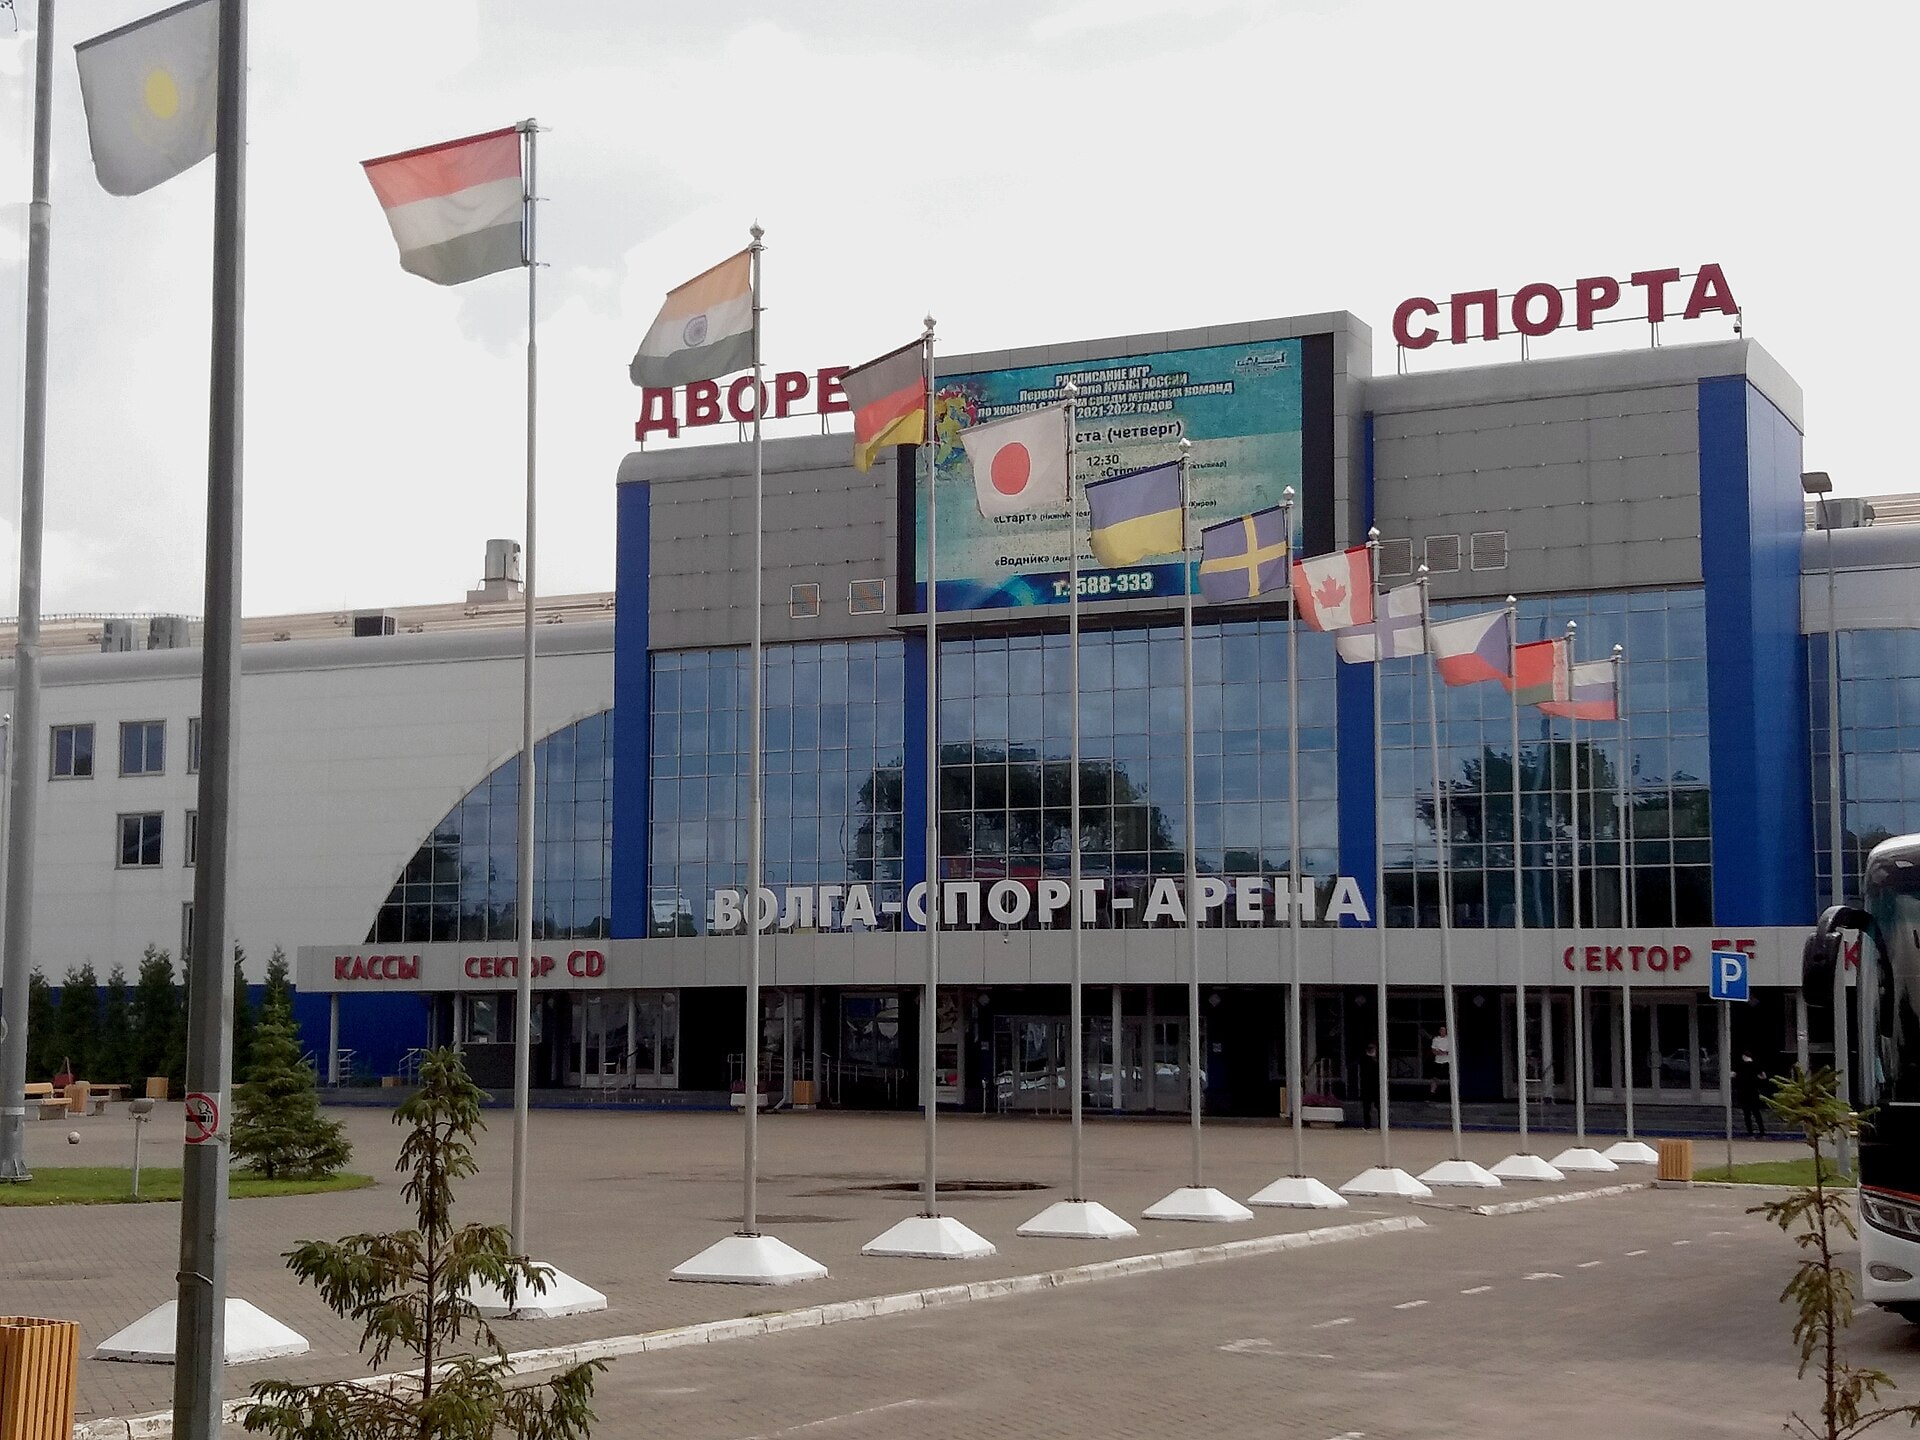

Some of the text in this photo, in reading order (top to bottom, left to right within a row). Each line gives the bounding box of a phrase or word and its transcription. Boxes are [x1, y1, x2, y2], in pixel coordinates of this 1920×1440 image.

[635, 263, 1739, 442] ДВОРЕ СПОРТА
[1055, 365, 1151, 386] РАСПИСАНИЕ ИГР
[1103, 378, 1141, 393] КУБКА
[1142, 373, 1188, 389] РОССИИ
[1184, 381, 1234, 396] команд
[1076, 402, 1136, 418] 2021-2022
[1108, 421, 1182, 443] (четверг)
[1087, 454, 1119, 466] 12:30
[334, 955, 420, 980] КАССЫ
[1720, 957, 1743, 994] P
